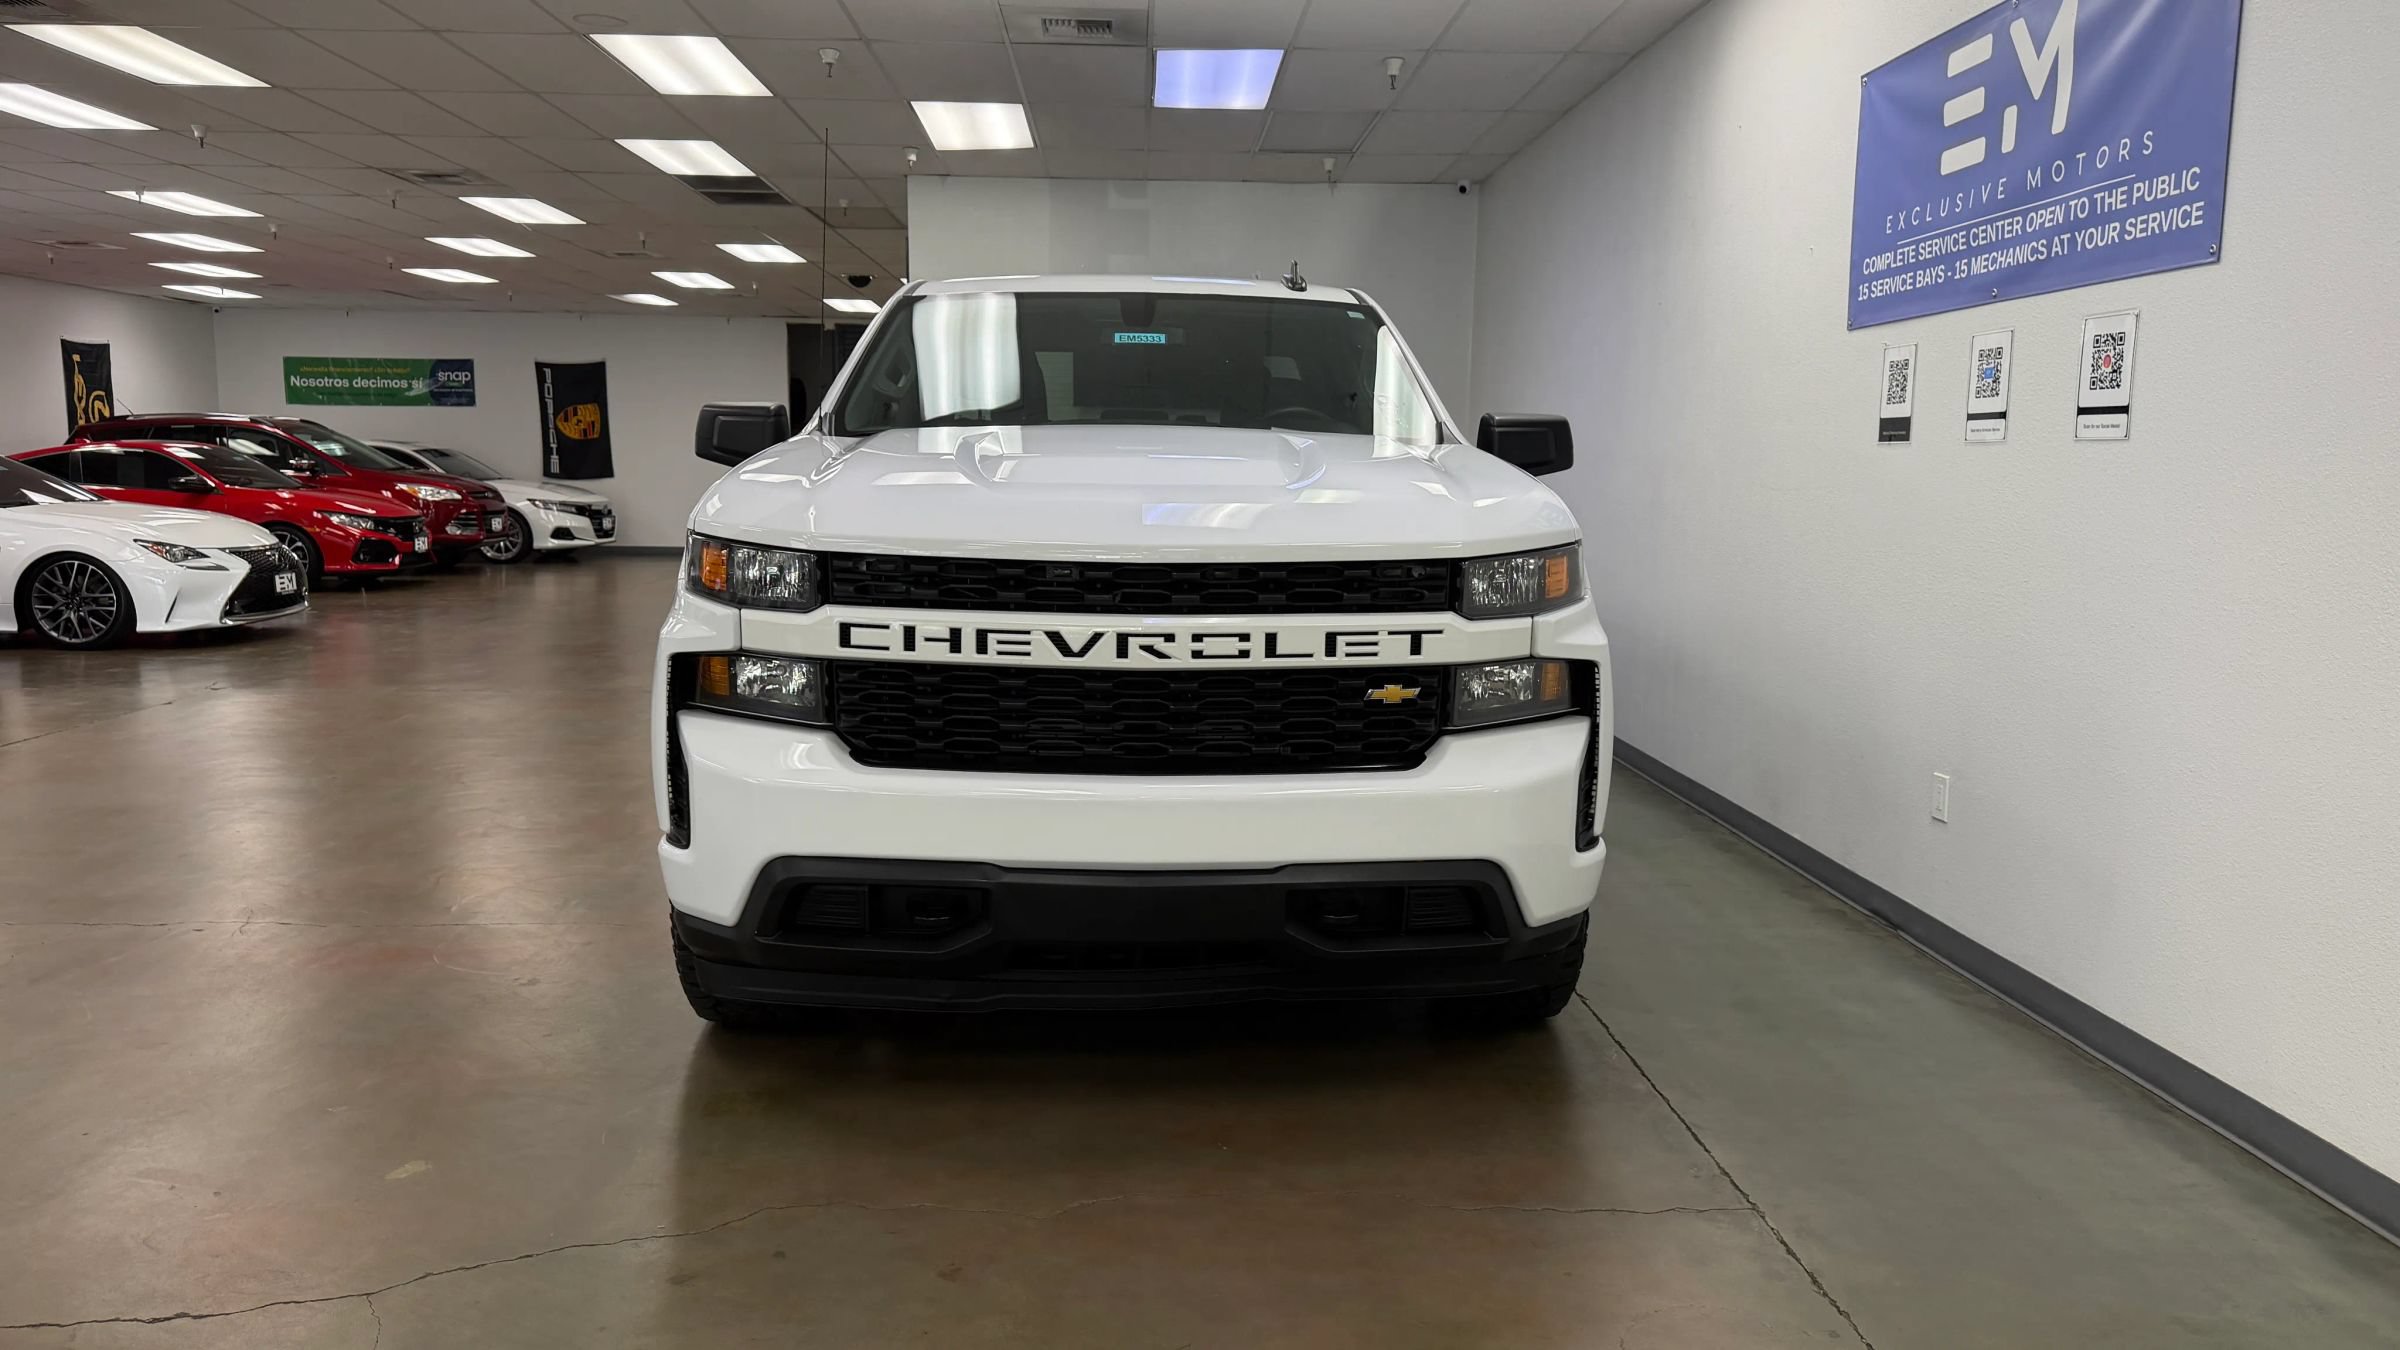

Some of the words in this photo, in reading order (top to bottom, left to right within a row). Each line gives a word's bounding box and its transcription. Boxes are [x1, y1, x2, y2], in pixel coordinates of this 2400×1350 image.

[1940, 0, 2079, 176] EM
[1863, 243, 1916, 276] COMPLETE
[1918, 231, 1967, 262] SERVICE
[1970, 216, 2022, 248] CENTER
[2026, 203, 2065, 233] OPEN
[2068, 196, 2089, 222] TO
[2094, 184, 2128, 214] THE
[2132, 166, 2201, 206] PUBLIC
[1886, 178, 2007, 234] EXCLUSIVE
[2027, 131, 2153, 192] MOTORS
[1858, 283, 1869, 302] 15
[1870, 270, 1914, 299] SERVICE
[1916, 263, 1945, 289] BAYS
[1954, 259, 1968, 280] 15
[1970, 239, 2047, 277] MECHANICS
[2051, 233, 2071, 258] AT
[2075, 222, 2120, 251] YOUR
[2124, 201, 2205, 241] SERVICE
[290, 375, 349, 388] Nosotros
[353, 377, 408, 389] decimos
[438, 371, 471, 384] snap
[1119, 334, 1162, 343] EM5333
[543, 367, 560, 474] PORSCHE
[838, 622, 1444, 660] CHEVROLET
